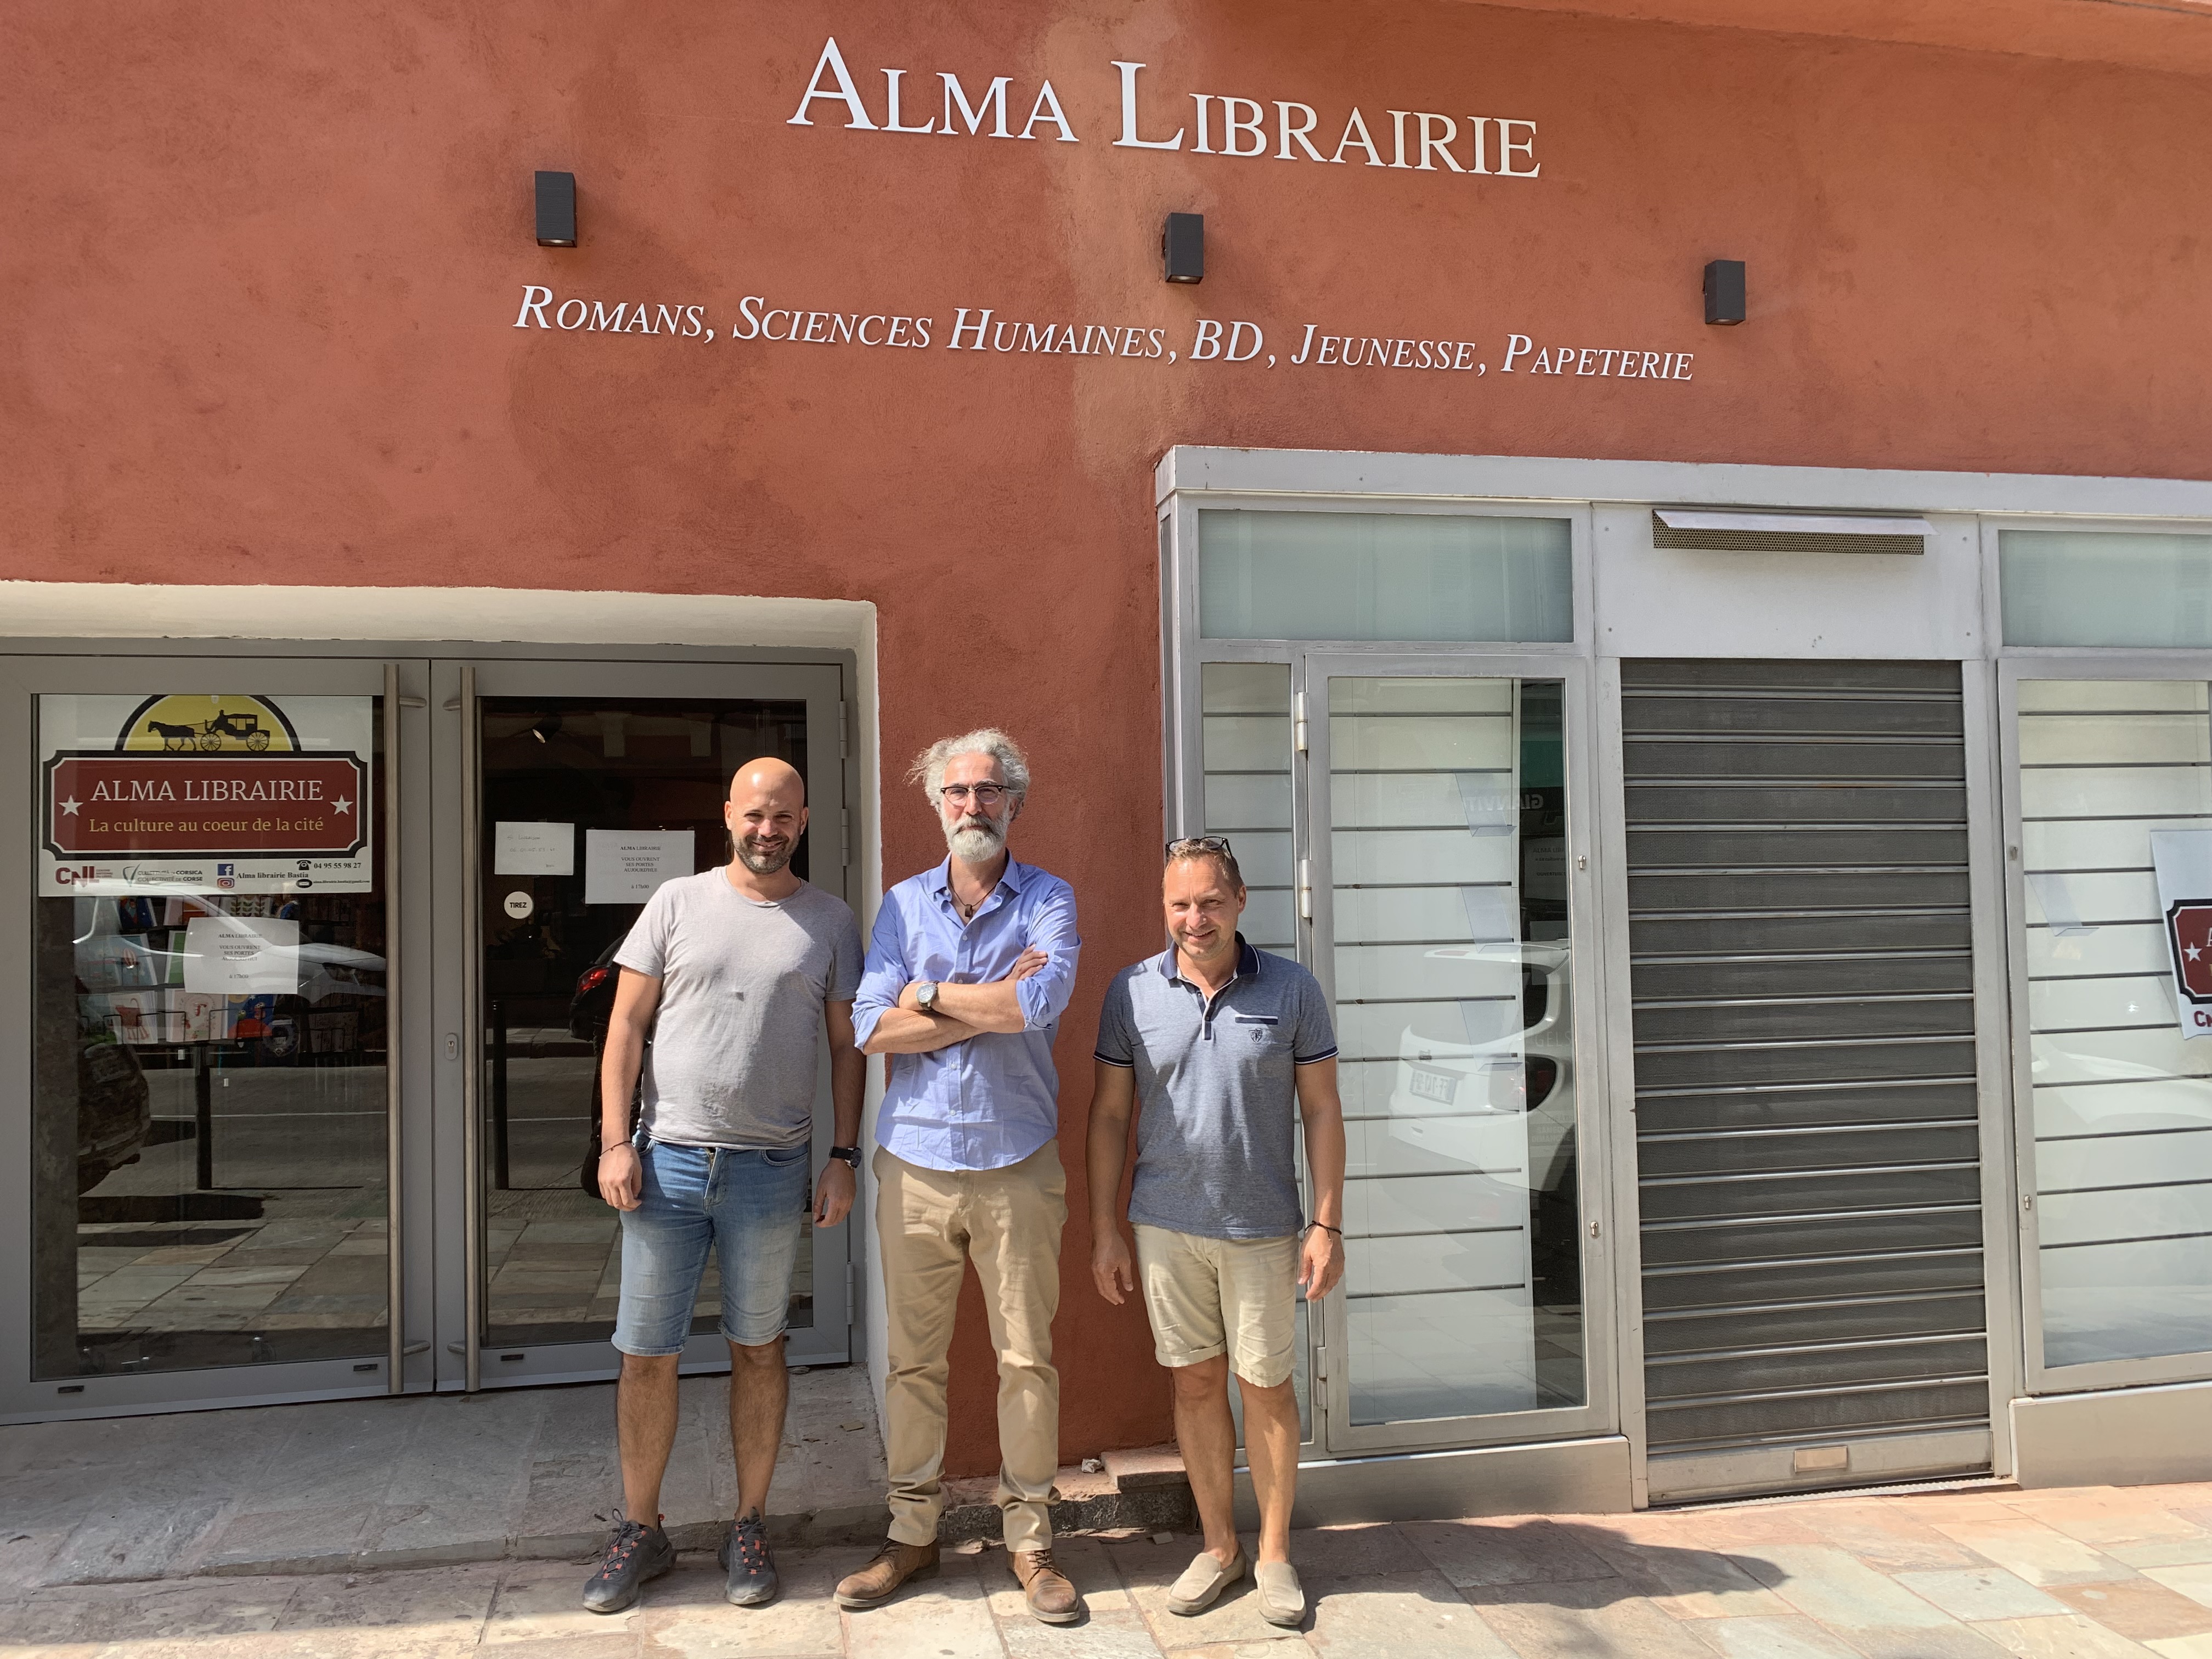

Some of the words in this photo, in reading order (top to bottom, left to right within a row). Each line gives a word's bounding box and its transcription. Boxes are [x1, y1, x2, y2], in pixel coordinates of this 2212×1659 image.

[787, 37, 1080, 143] ALMA
[1111, 60, 1542, 178] LIBRAIRIE
[512, 285, 714, 343] ROMANS,
[733, 296, 933, 348] SCIENCES
[947, 308, 1177, 365] HUMAINES,
[1189, 319, 1276, 369] BD,
[1291, 324, 1486, 377] JEUNESSE,
[1500, 334, 1694, 381] PAPETERIE
[90, 780, 177, 802] ALMA
[184, 780, 324, 802] LIBRAIRIE
[89, 818, 109, 833] La
[114, 817, 174, 832] culture
[178, 821, 198, 832] au
[202, 821, 249, 832] coeur
[252, 817, 271, 832] de
[276, 817, 290, 831] la
[294, 816, 324, 831] cité
[55, 866, 95, 887] CNL
